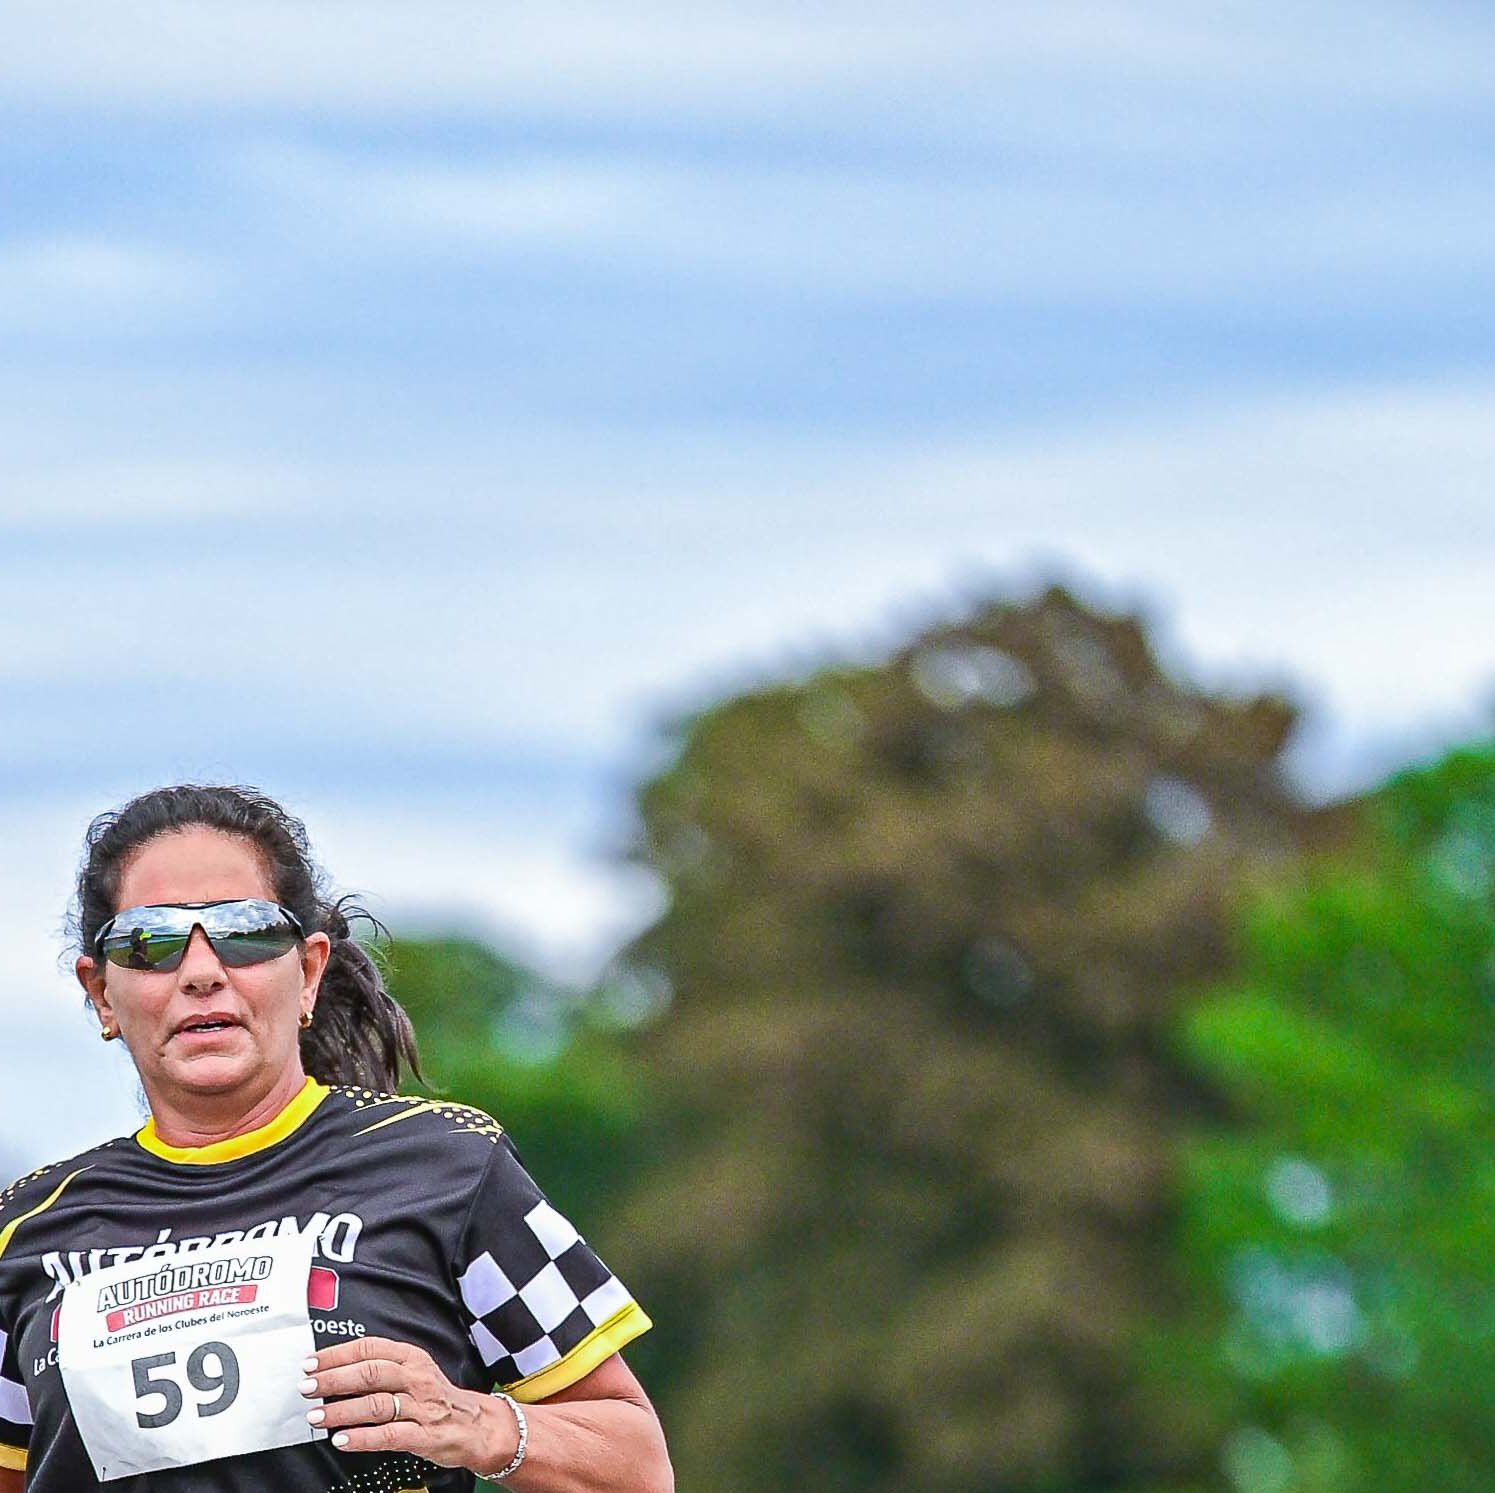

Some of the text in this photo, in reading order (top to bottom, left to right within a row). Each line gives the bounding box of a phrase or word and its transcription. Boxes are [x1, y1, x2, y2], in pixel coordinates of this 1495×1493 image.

[97, 1256, 273, 1313] AUTÓDROMO
[123, 1287, 240, 1325] RUNNING RACE
[93, 1305, 269, 1348] La Carrera de los Clubes del Noroeste
[310, 1319, 366, 1337] oeste
[130, 1341, 240, 1429] 59
